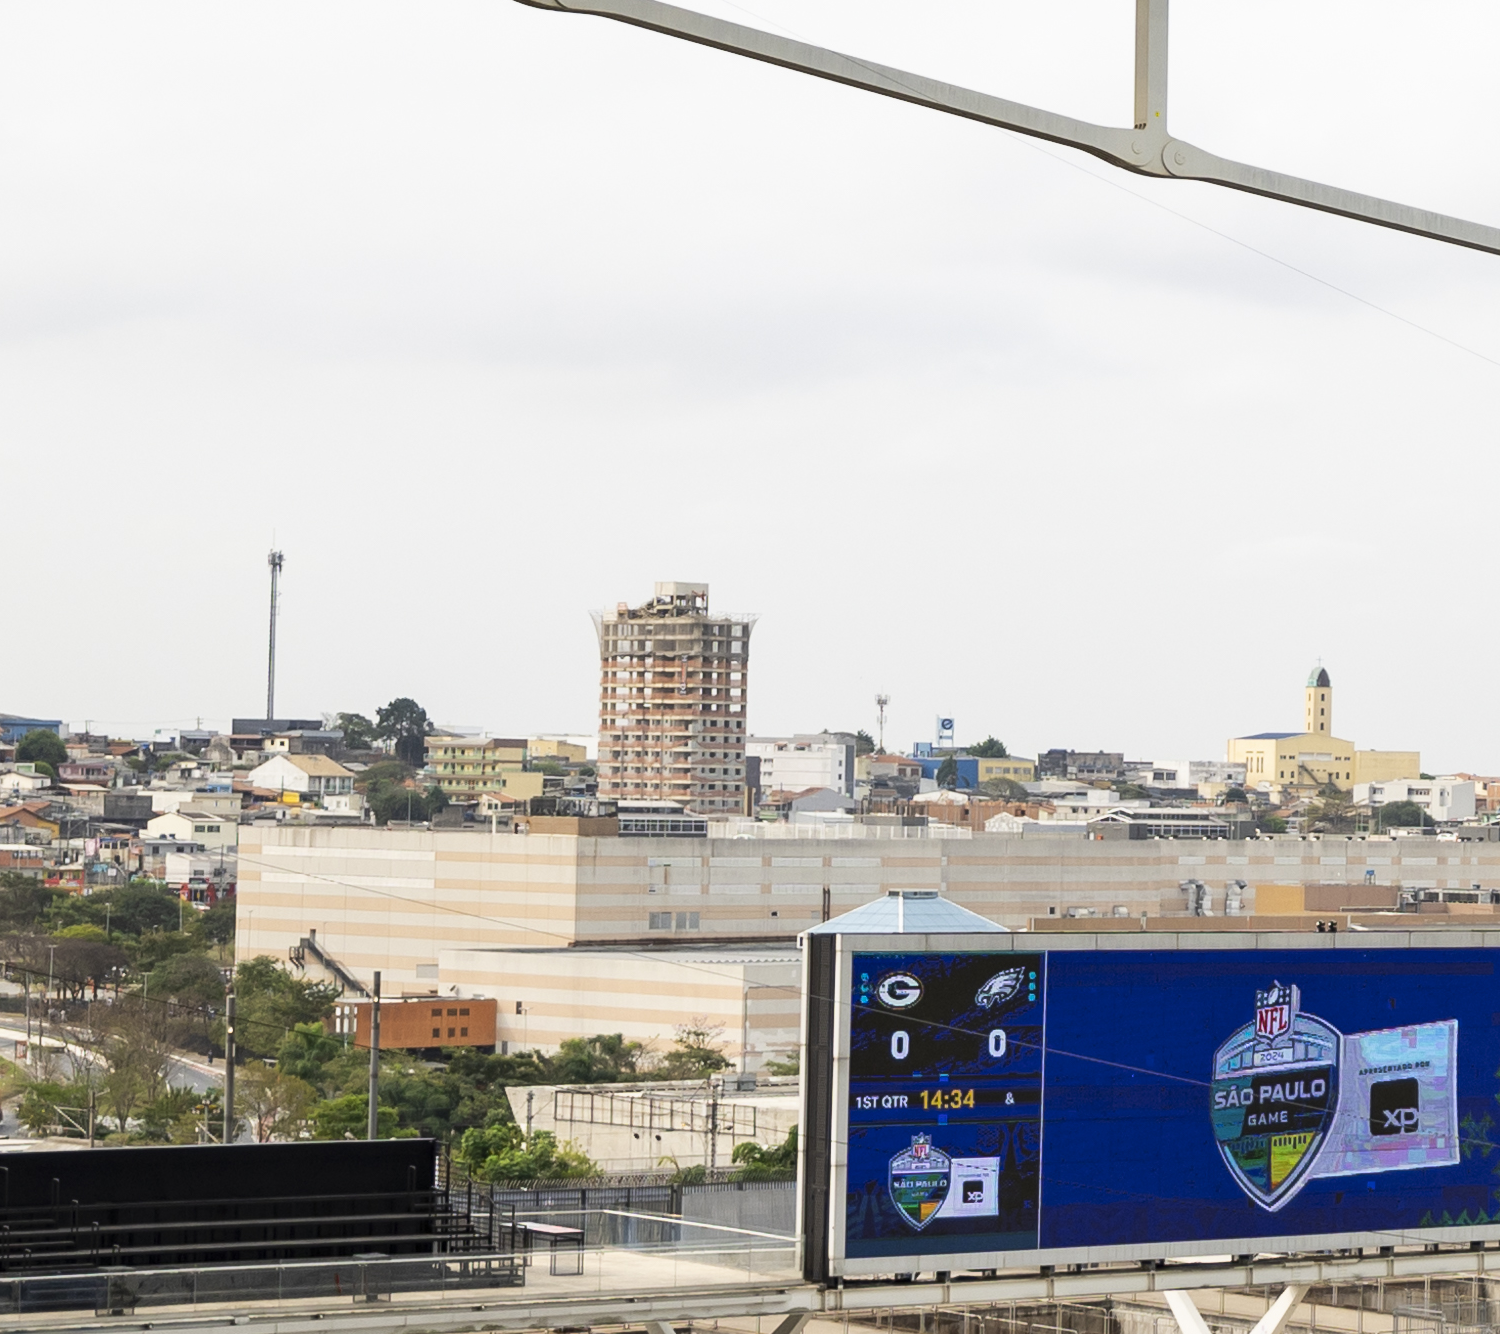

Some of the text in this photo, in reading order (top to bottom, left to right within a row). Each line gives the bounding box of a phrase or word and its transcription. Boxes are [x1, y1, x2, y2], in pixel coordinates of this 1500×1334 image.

[1257, 1006, 1288, 1035] NFL
[891, 1029, 1007, 1060] 0 0
[1260, 1051, 1285, 1062] 2024
[855, 1088, 1015, 1110] 1ST QTR 14:34 &
[1214, 1078, 1326, 1110] SÃO PAULO
[1247, 1110, 1288, 1126] GAME
